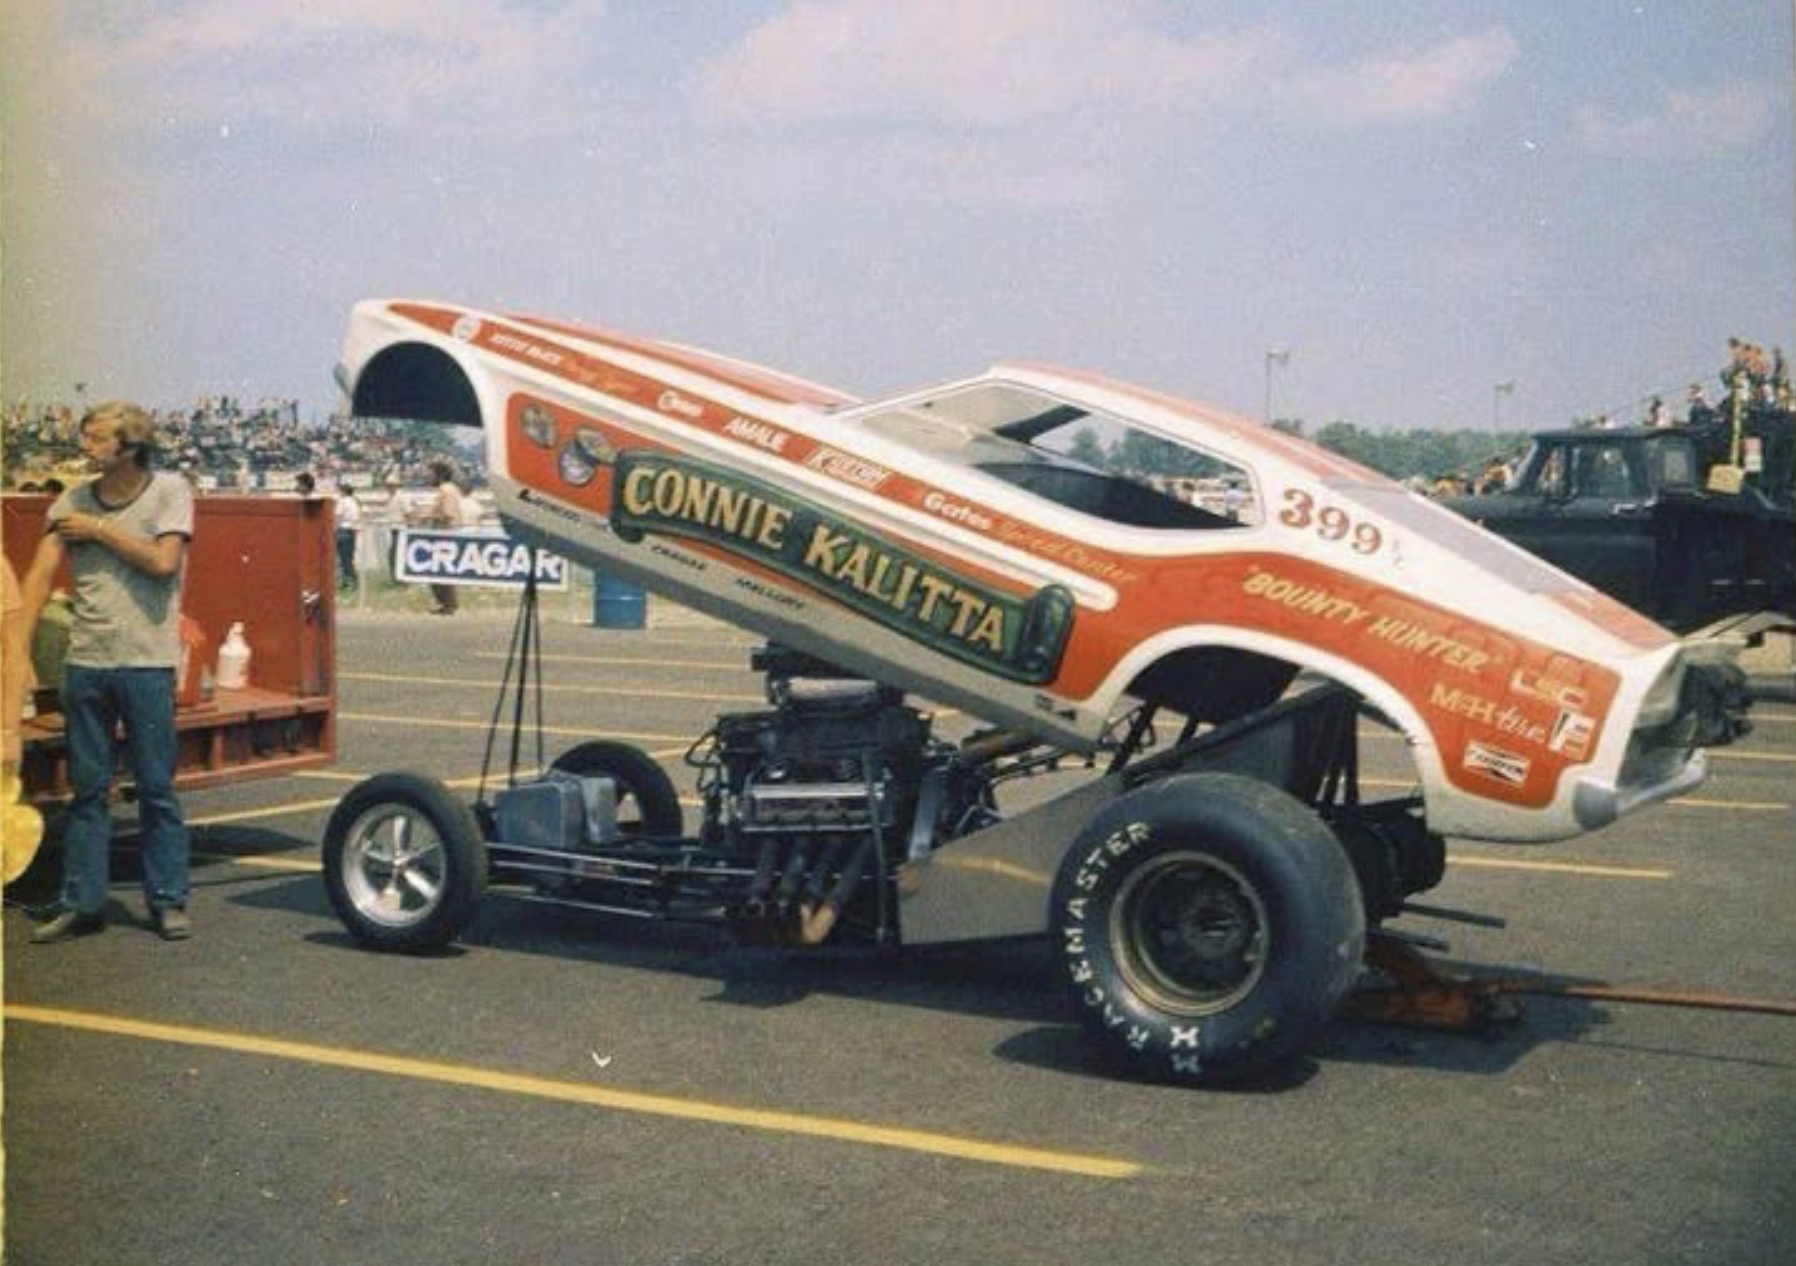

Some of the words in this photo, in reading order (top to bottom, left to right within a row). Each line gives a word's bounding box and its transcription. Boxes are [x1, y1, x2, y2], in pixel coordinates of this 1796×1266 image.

[407, 539, 561, 579] CRAGAR
[625, 466, 793, 549] CONNIE
[805, 522, 1005, 650] KALITTA
[1279, 488, 1382, 555] 399
[1064, 820, 1150, 1050] RACEMASTER
